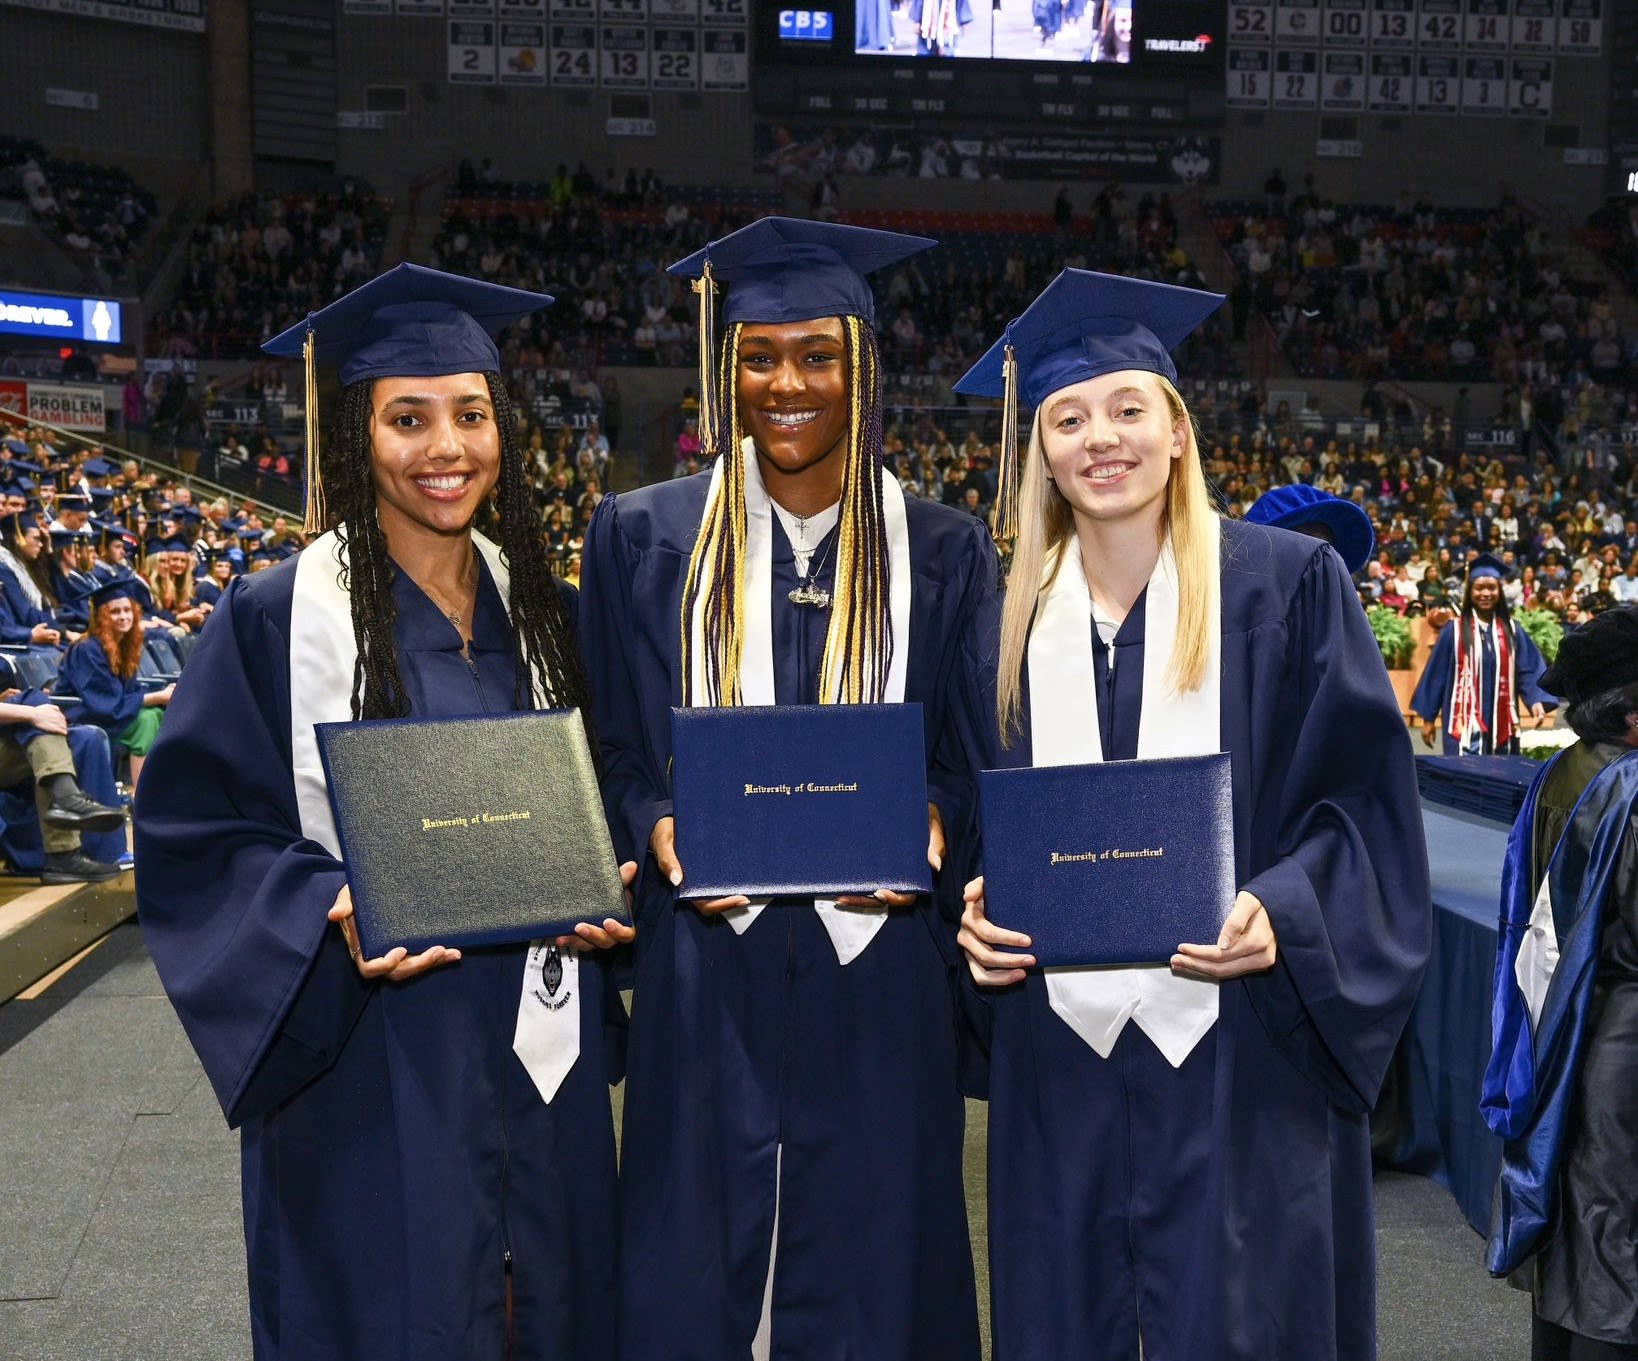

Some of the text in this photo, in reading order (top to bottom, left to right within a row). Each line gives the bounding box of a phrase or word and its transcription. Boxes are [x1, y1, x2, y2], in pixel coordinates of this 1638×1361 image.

[779, 10, 828, 29] CBS
[1235, 9, 1266, 31] 52
[1330, 12, 1361, 35] 00
[1381, 14, 1406, 36] 13
[1425, 16, 1456, 39] 42
[1571, 21, 1590, 43] 50
[464, 49, 479, 70] 2
[557, 51, 591, 74] 24
[612, 52, 638, 75] 13
[658, 54, 690, 77] 22
[1287, 74, 1304, 98] 22
[1428, 80, 1447, 103] 13
[1520, 82, 1540, 108] C
[30, 396, 103, 414] PROBLEM
[234, 407, 259, 421] 113
[30, 409, 104, 427] GAMBLING
[1492, 429, 1516, 446] 116
[744, 782, 858, 797] University of Connecticut
[421, 810, 531, 832] University of Connecticut
[1050, 847, 1163, 866] University of Connecticut
